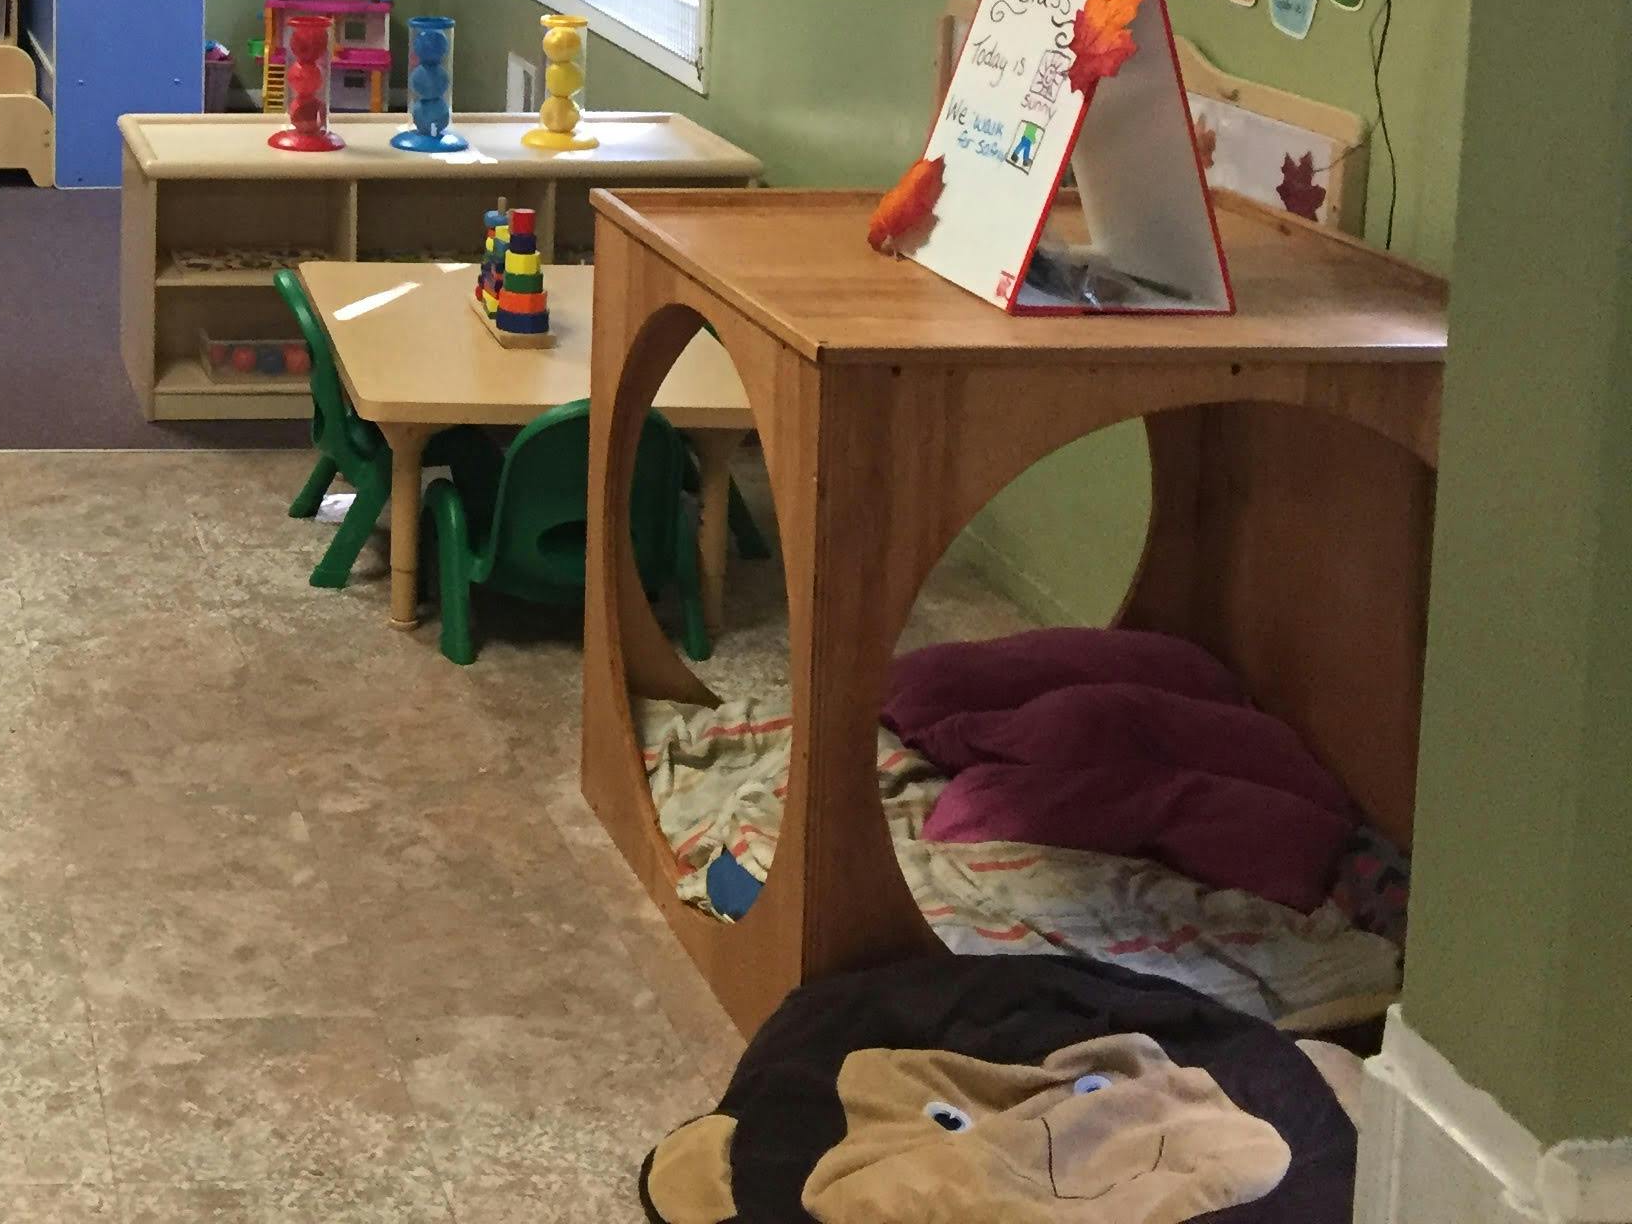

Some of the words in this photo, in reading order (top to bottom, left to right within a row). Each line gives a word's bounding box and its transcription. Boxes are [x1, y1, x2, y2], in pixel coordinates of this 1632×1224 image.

[972, 35, 1008, 88] Today
[1013, 56, 1026, 76] is
[945, 94, 968, 125] We
